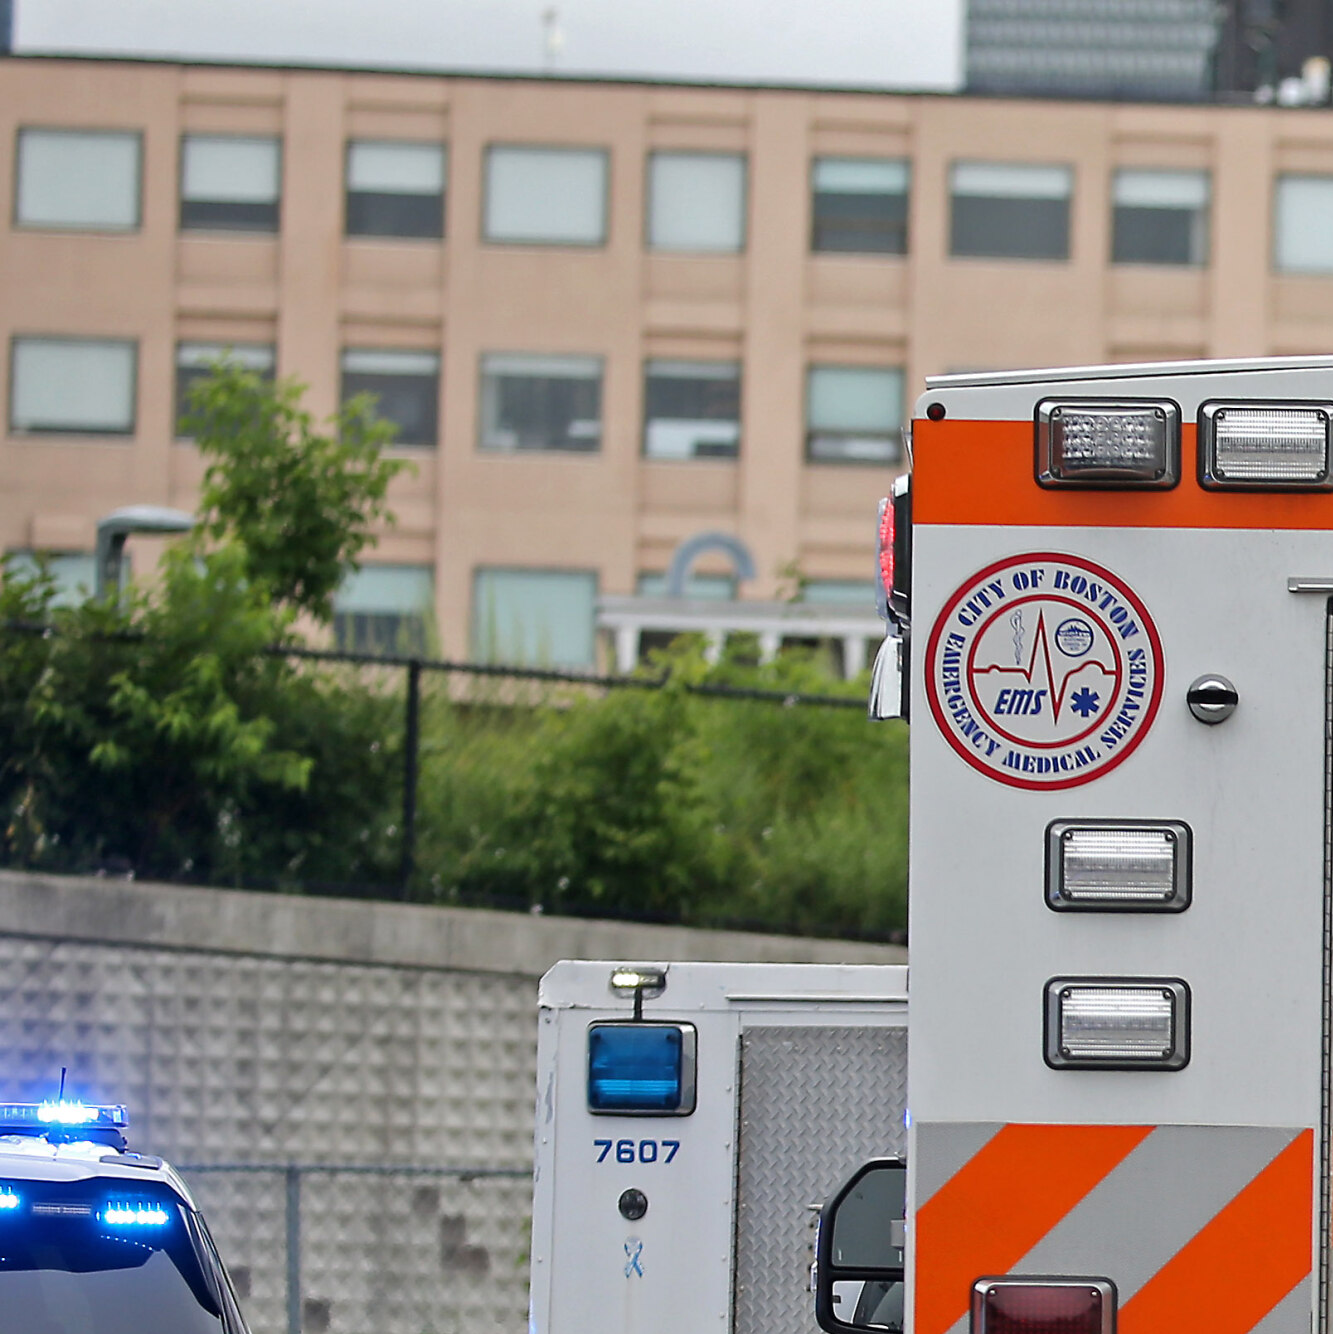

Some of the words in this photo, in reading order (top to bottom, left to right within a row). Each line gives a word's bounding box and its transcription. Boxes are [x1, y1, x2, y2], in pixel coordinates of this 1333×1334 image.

[958, 580, 1006, 626] CITY
[1013, 569, 1045, 590] OF
[1054, 570, 1139, 640] BOSTON
[942, 632, 1001, 757] EMERGENCY
[1002, 745, 1101, 773] MEDICAL
[1100, 648, 1147, 749] SERVICES
[993, 689, 1047, 715] EMS
[594, 1140, 680, 1163] 7607
